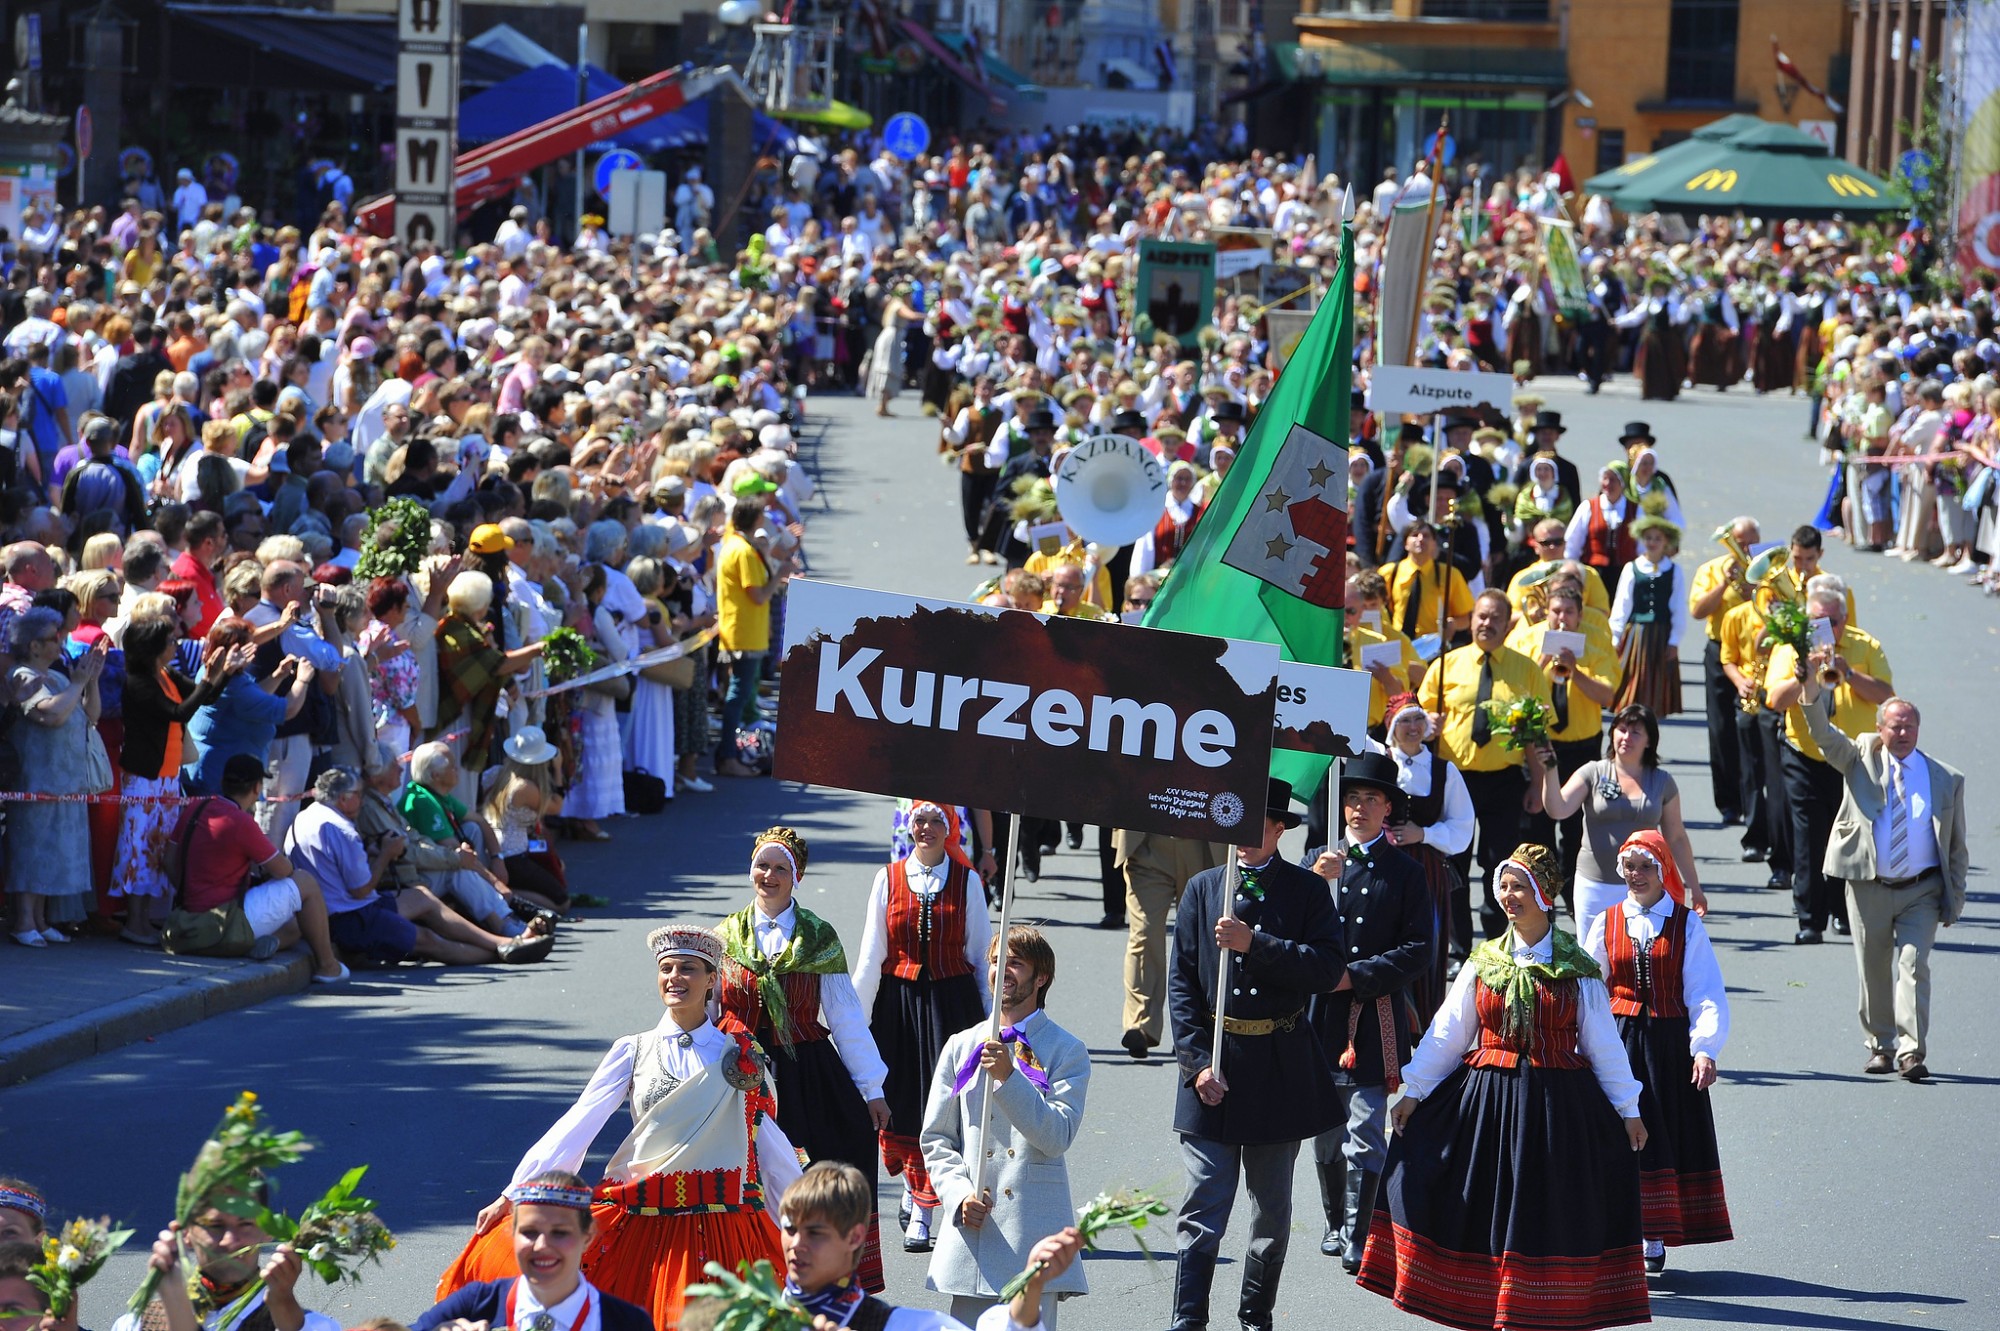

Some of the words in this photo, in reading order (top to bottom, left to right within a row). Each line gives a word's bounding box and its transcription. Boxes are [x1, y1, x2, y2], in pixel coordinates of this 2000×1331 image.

[1409, 384, 1472, 399] Aizpute
[1061, 438, 1163, 491] KAZDANGA
[815, 642, 1236, 768] Kurzeme
